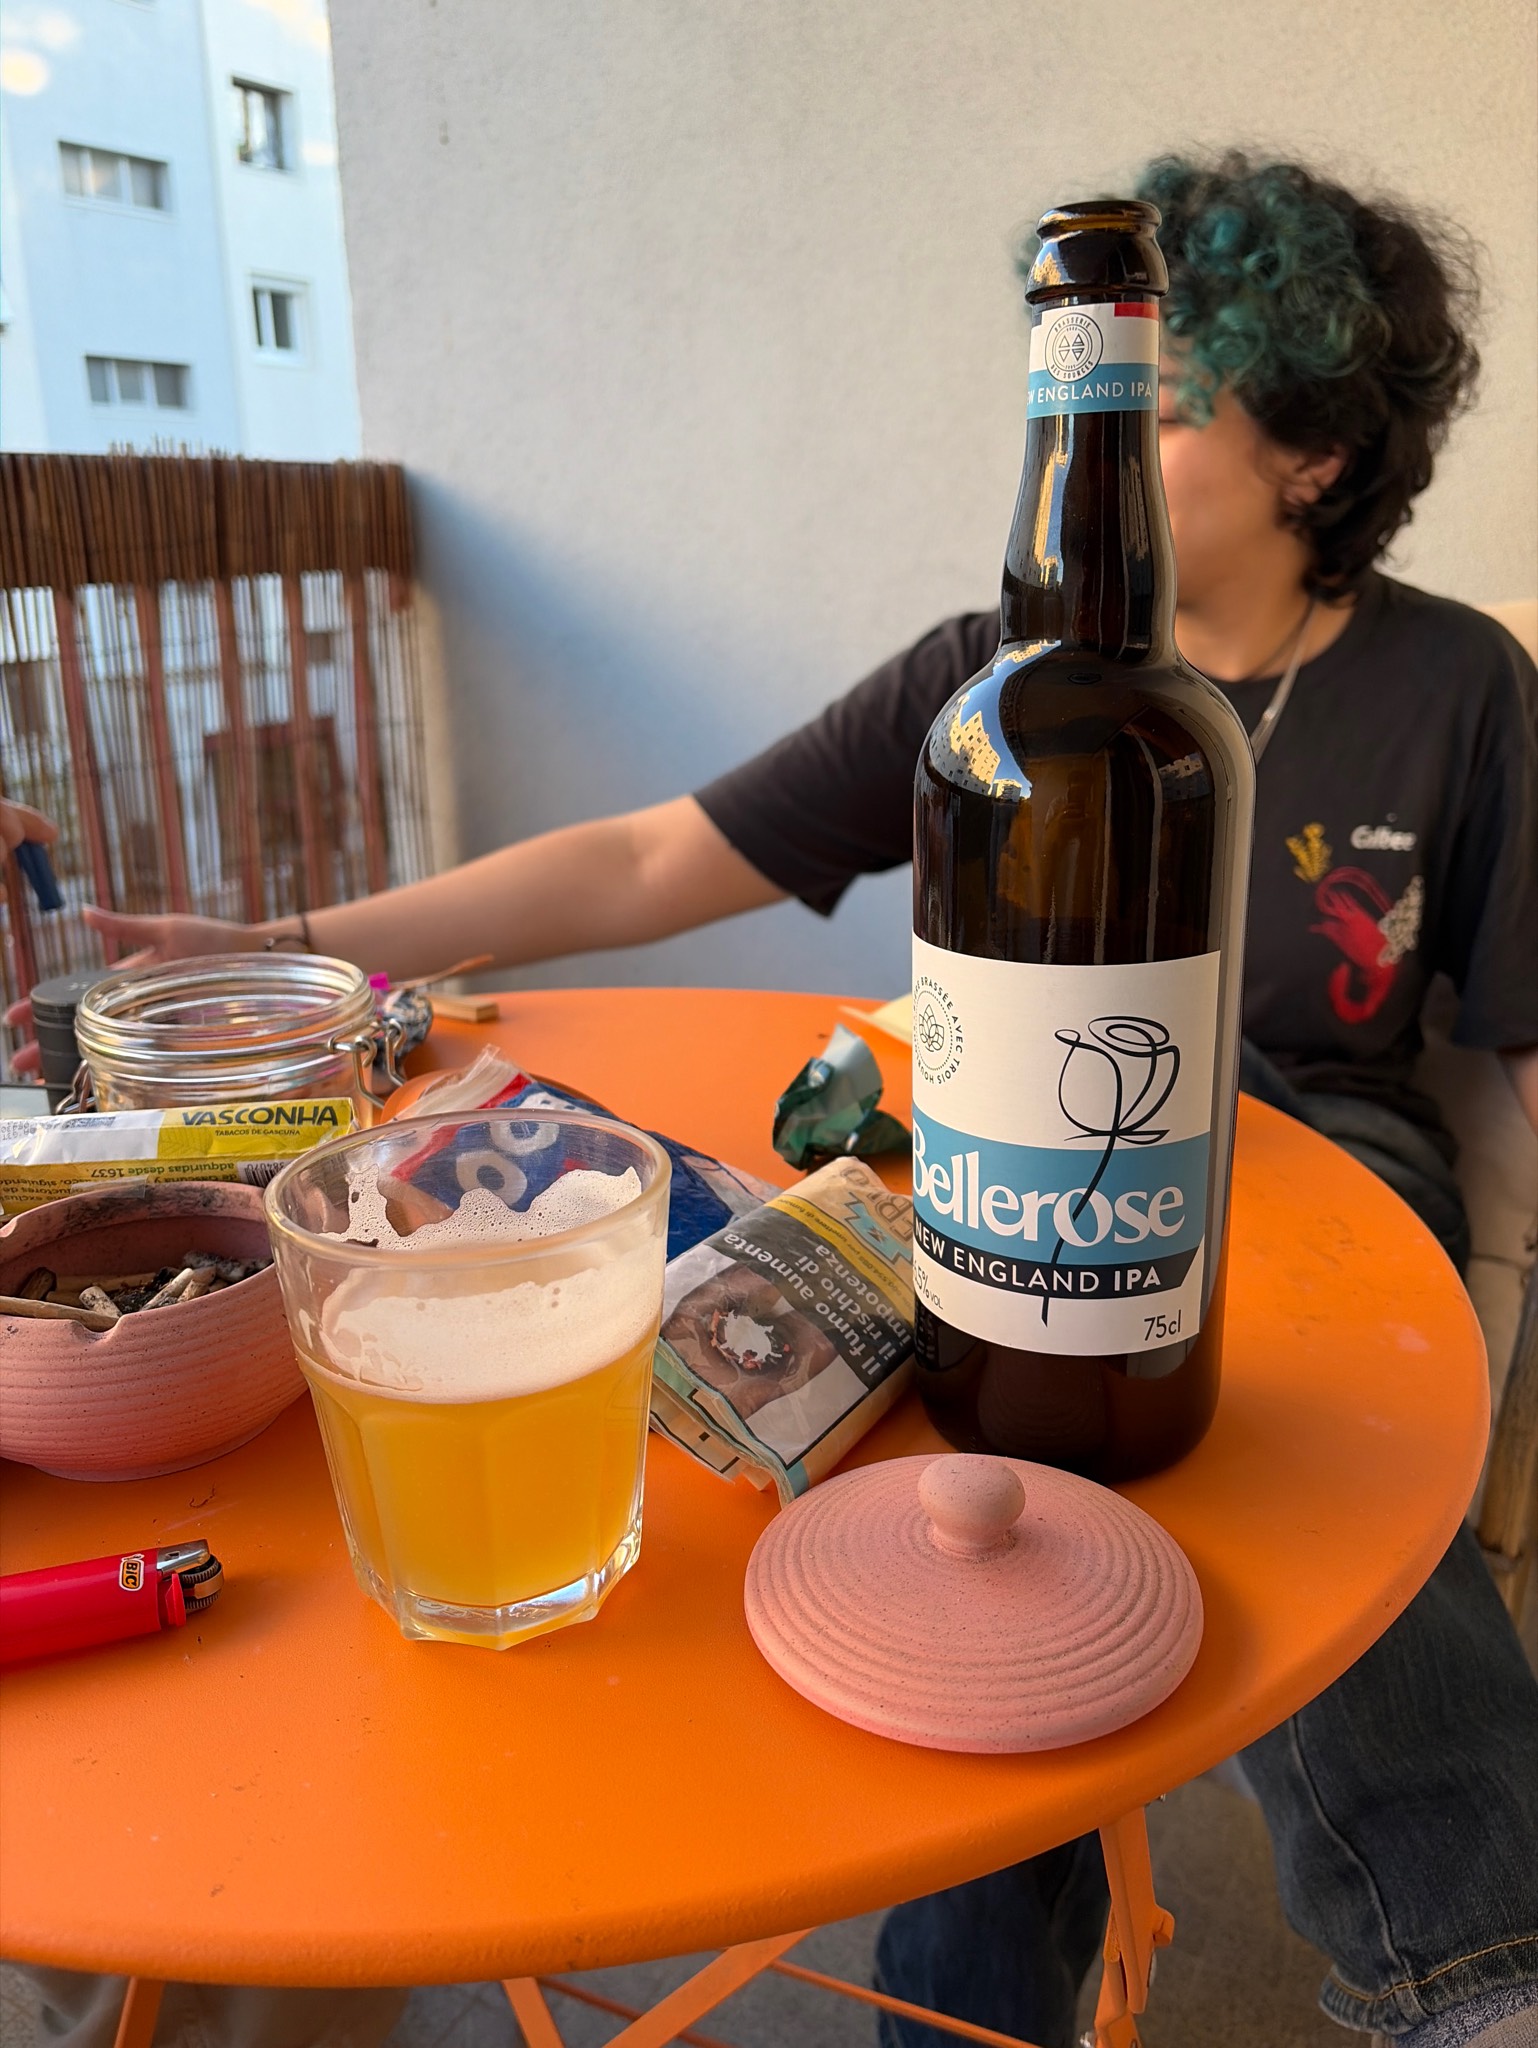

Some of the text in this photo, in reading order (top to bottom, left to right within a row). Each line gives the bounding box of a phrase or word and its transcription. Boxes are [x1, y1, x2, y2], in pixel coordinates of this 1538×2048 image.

[1054, 316, 1091, 332] BRASSERIE
[1050, 360, 1093, 379] DES SOURCES
[1037, 382, 1123, 403] ENGLAND
[1131, 381, 1152, 398] IPA
[920, 976, 954, 1010] BRASSÉE
[951, 1015, 964, 1054] AVEC
[936, 1057, 960, 1085] TROIS
[182, 1105, 338, 1127] VASCONHA
[215, 1129, 250, 1137] TABACOS
[251, 1128, 262, 1136] DE
[128, 1165, 165, 1175] desde
[168, 1162, 234, 1174] adquiridas
[912, 1117, 1186, 1248] Bellerose
[723, 1232, 815, 1301] aumenta
[915, 1216, 1161, 1294] NEW ENGLAND IPA
[795, 1255, 897, 1362] il rischio di
[815, 1243, 912, 1348] impotenza
[815, 1302, 869, 1358] fumo
[1143, 1309, 1182, 1341] 75cl
[858, 1352, 882, 1377] Il
[126, 1562, 138, 1587] BIC
